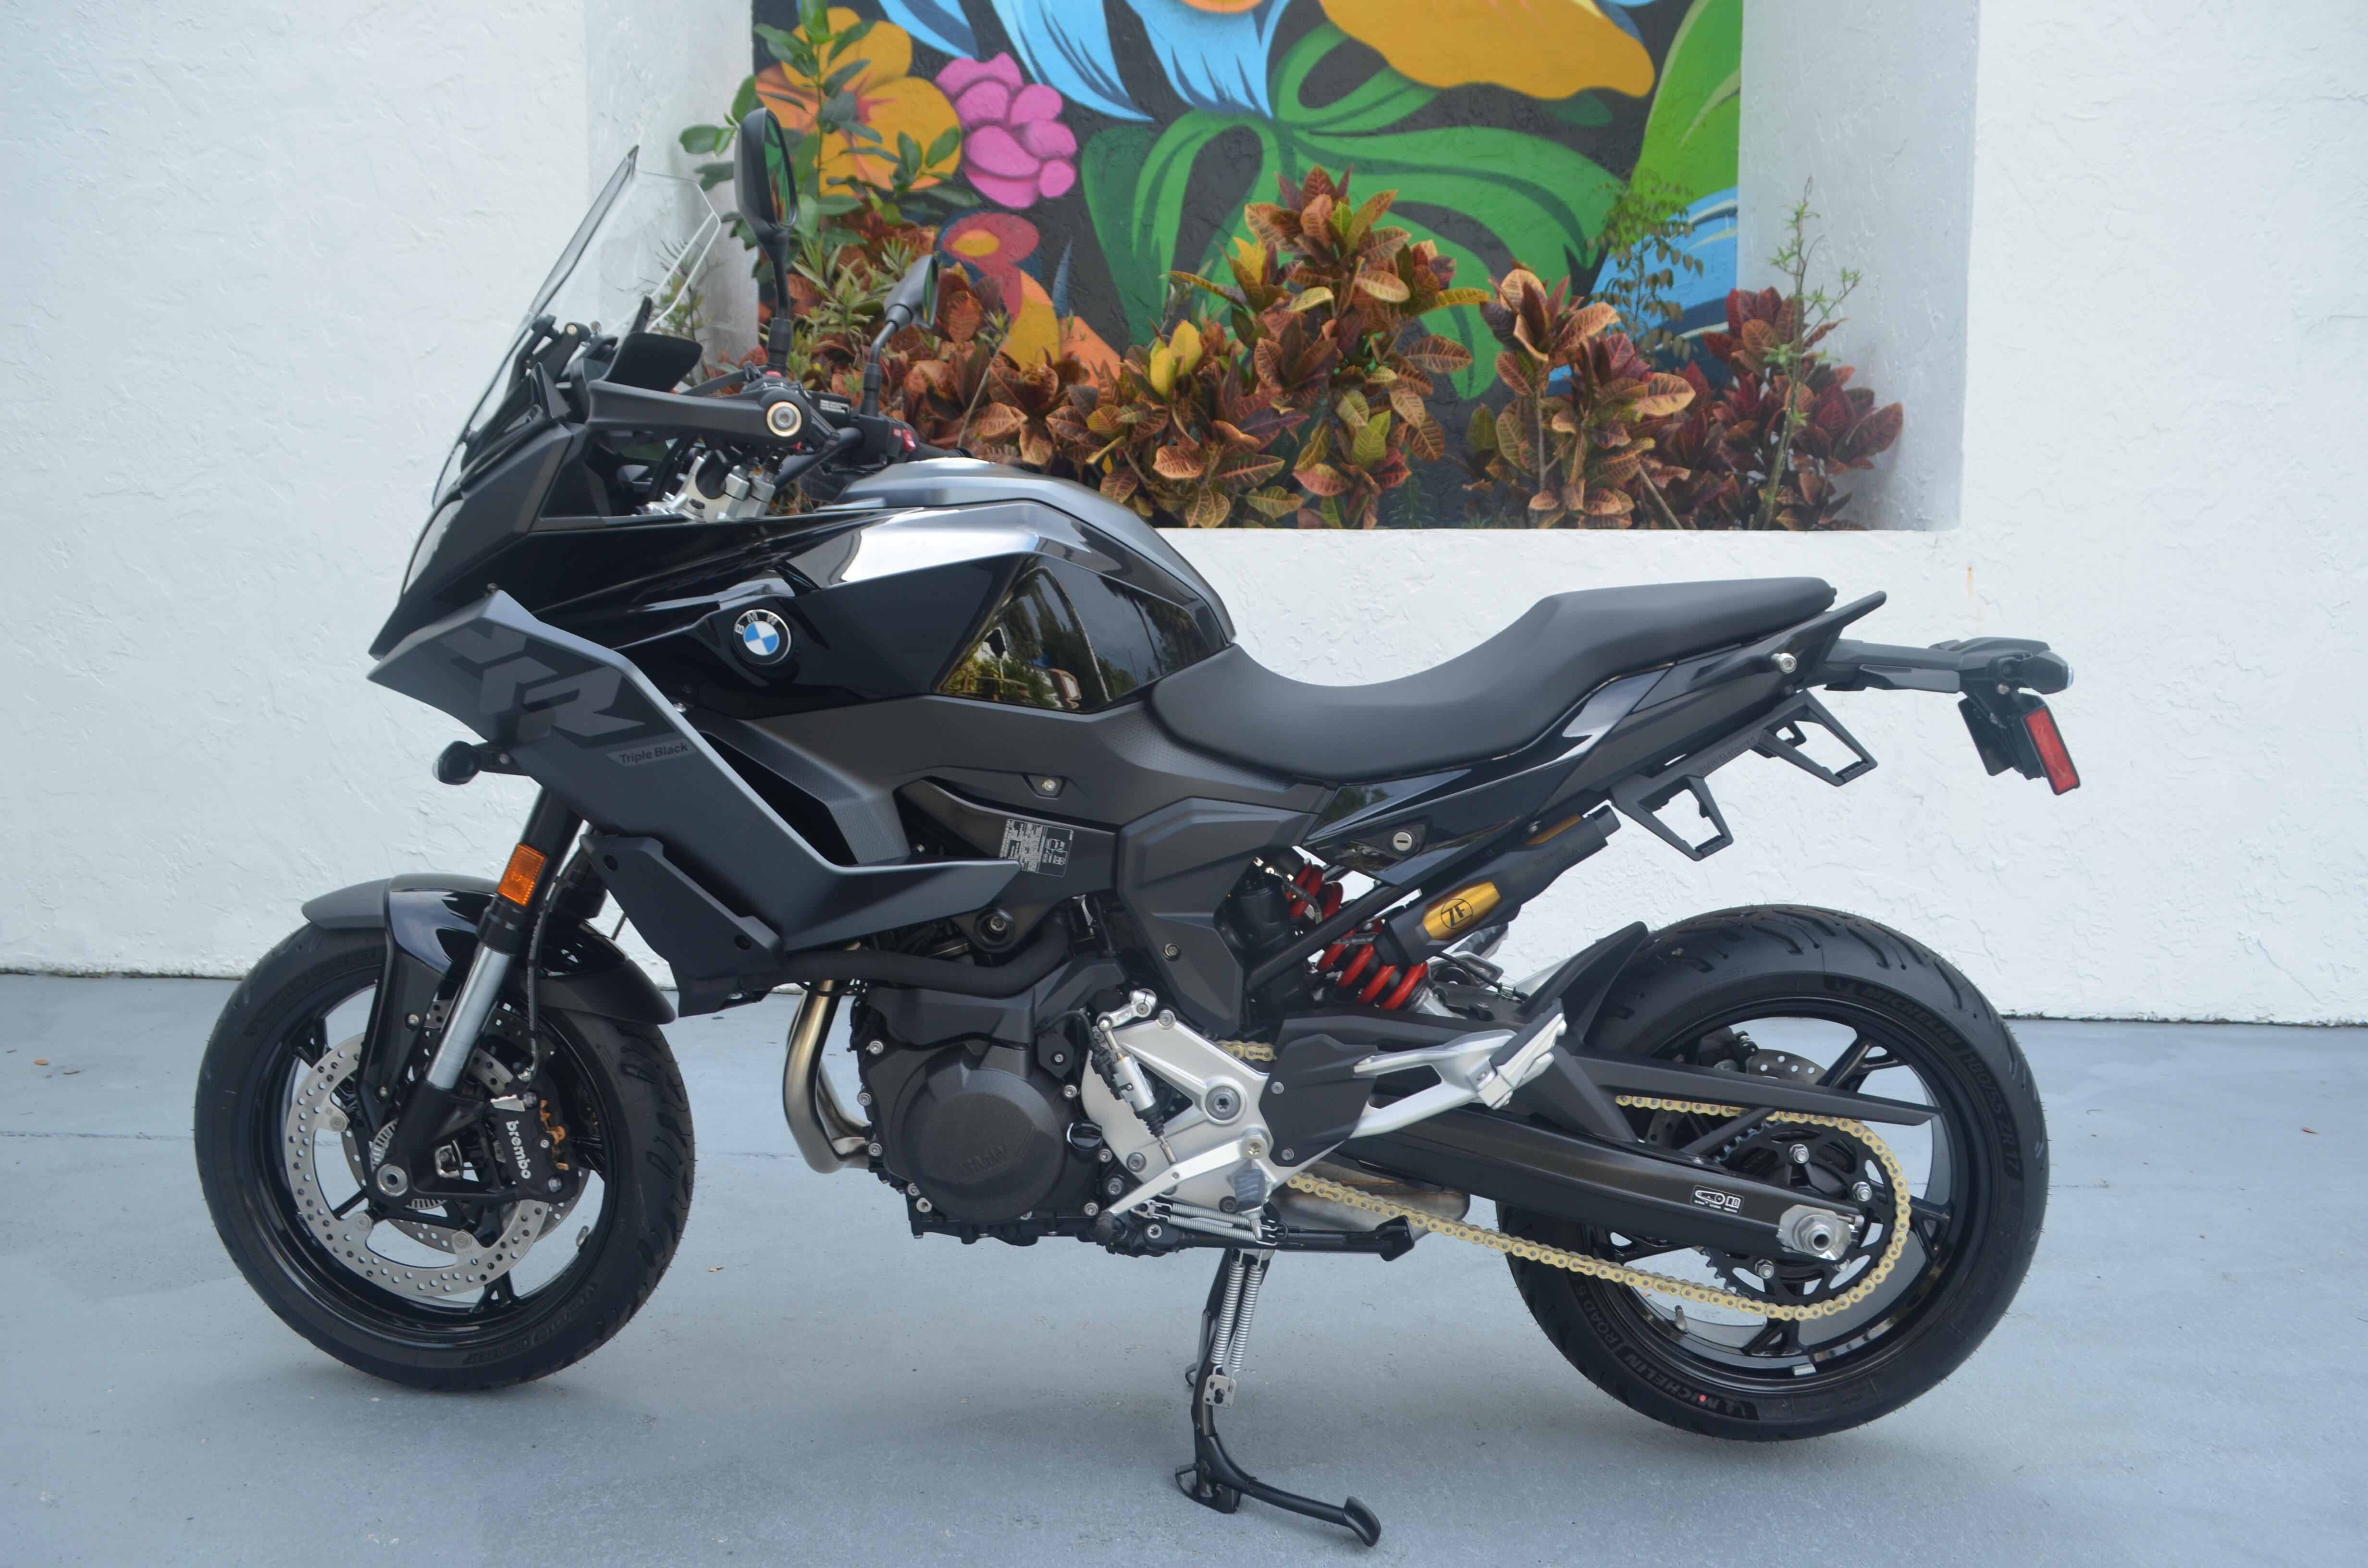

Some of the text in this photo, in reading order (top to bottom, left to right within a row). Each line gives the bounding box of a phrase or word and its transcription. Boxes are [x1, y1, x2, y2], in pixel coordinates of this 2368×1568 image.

[735, 611, 778, 634] BMW
[619, 743, 689, 763] Triple Black
[1441, 900, 1473, 927] ZF
[1861, 986, 2020, 1172] MICHELIN 180/55 ZR 17
[506, 1120, 531, 1179] brembo
[961, 1143, 1008, 1176] BMW
[1576, 1286, 1720, 1409] MICHELIN ROAD 6
